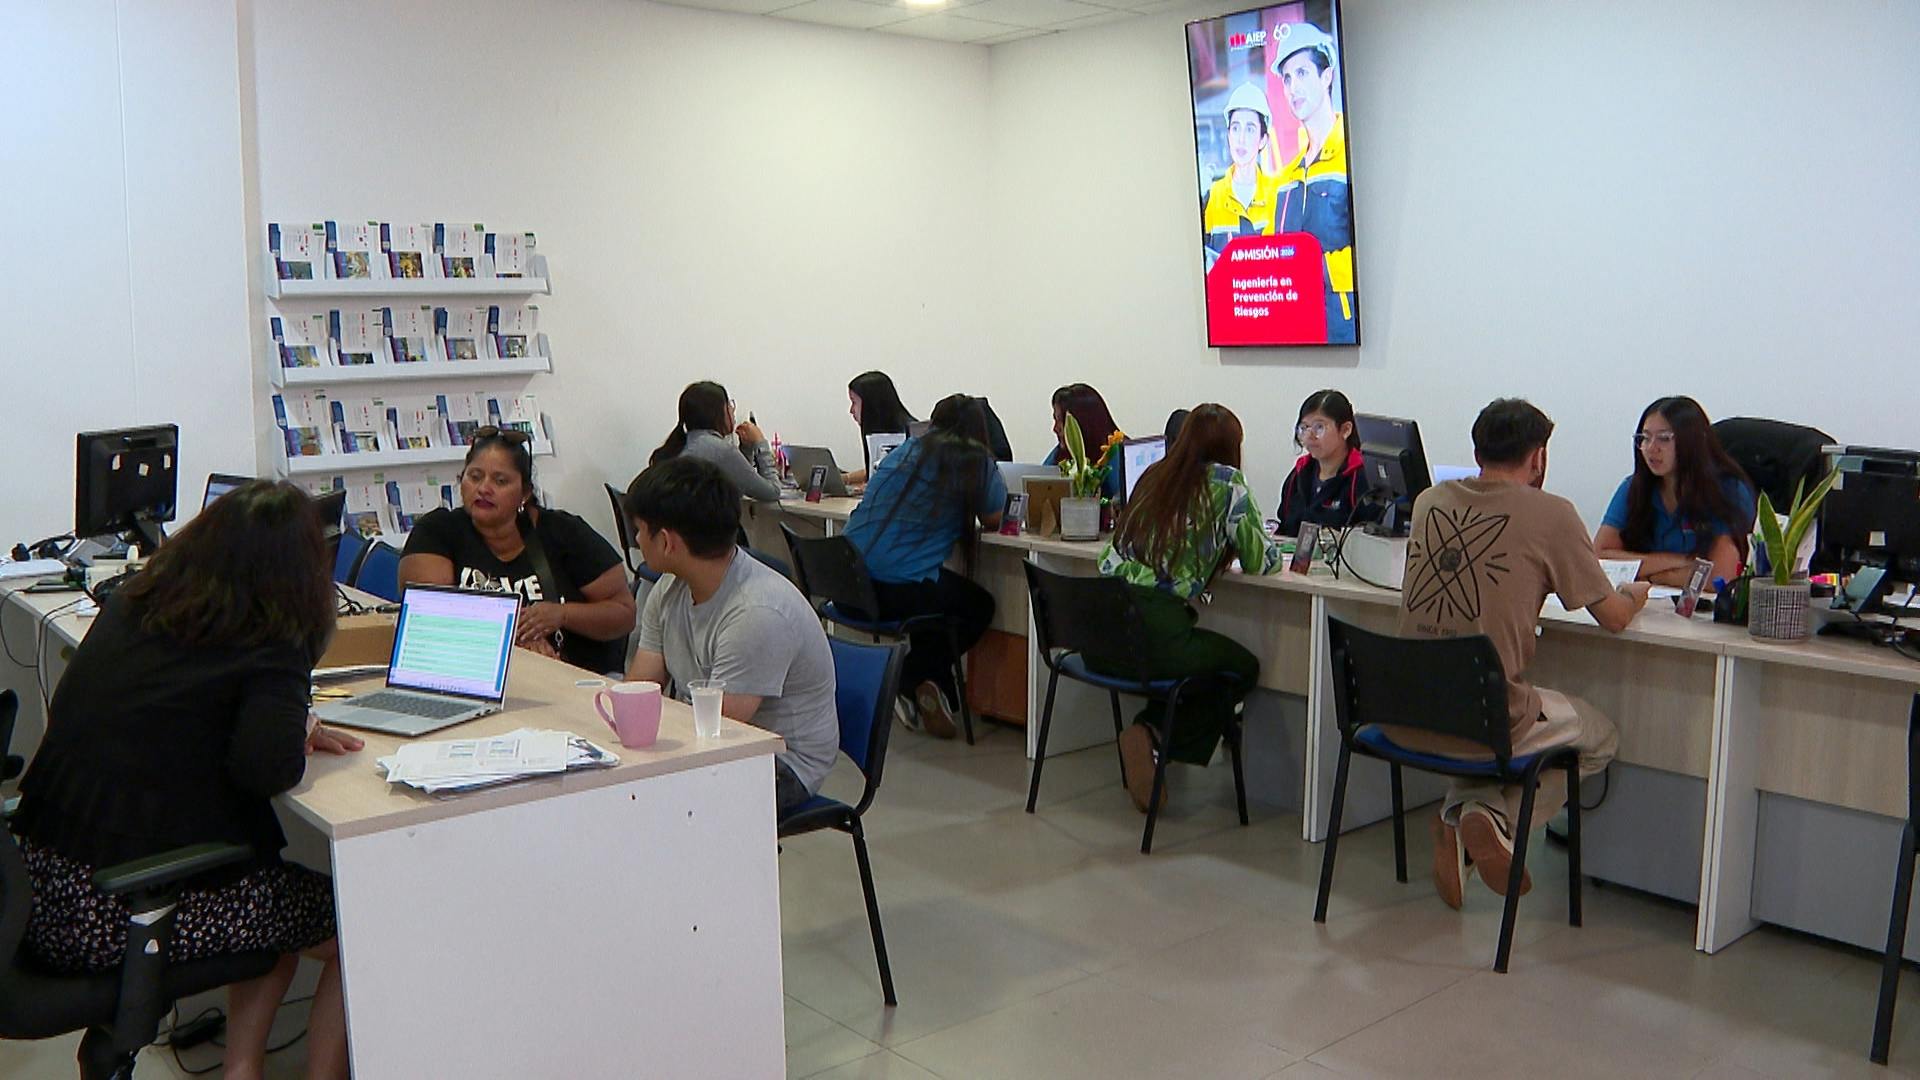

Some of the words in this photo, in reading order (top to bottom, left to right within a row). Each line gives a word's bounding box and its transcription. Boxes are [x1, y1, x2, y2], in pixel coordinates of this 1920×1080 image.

[1246, 30, 1267, 44] AIEP
[1273, 23, 1291, 41] 60
[1231, 245, 1279, 262] ADMISIÓN
[1232, 275, 1278, 291] Ingeniería
[1280, 277, 1292, 287] en
[1233, 290, 1284, 303] Prevención
[1286, 290, 1299, 302] de
[1234, 305, 1269, 319] Riesgos
